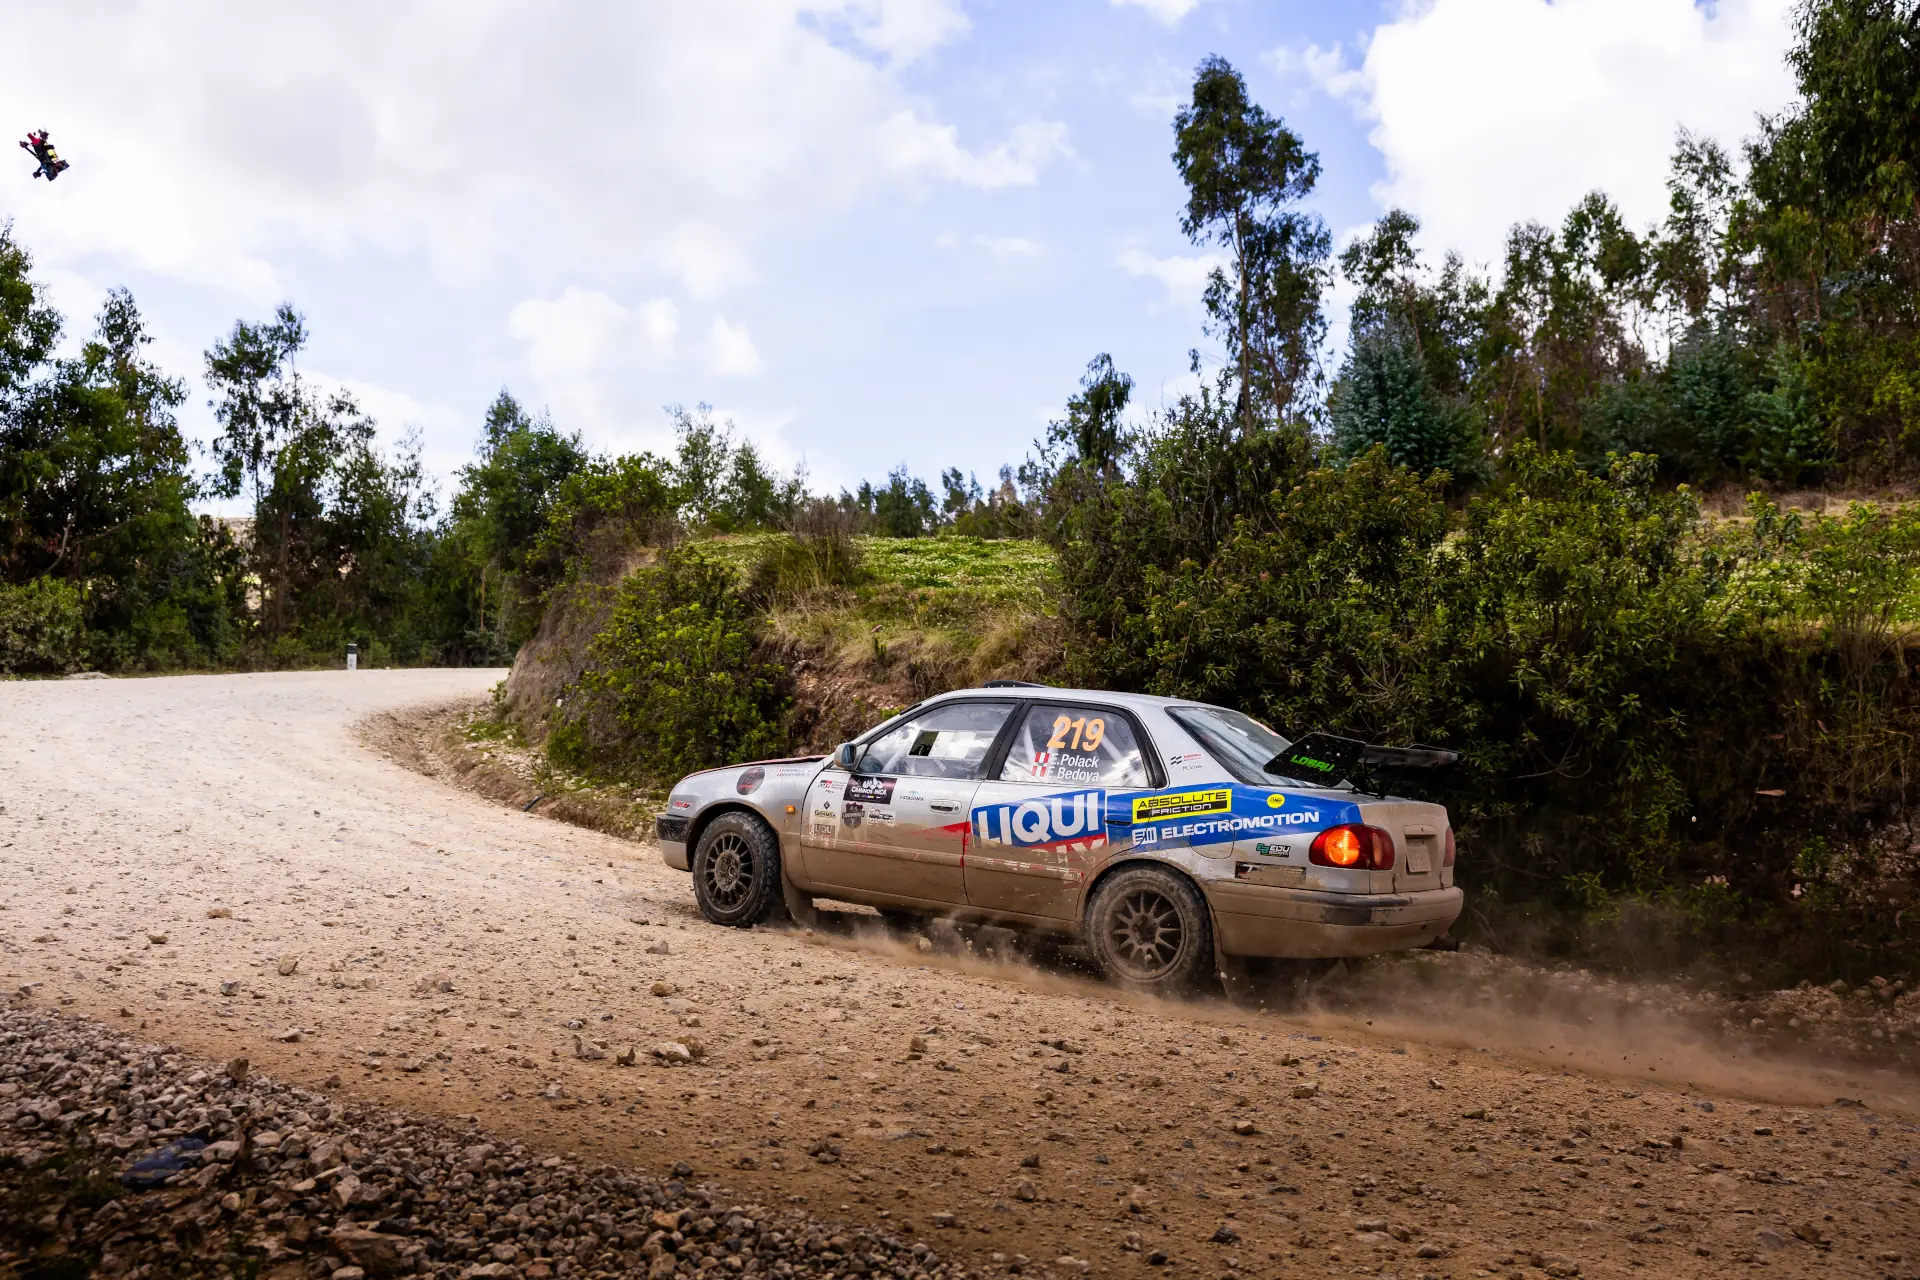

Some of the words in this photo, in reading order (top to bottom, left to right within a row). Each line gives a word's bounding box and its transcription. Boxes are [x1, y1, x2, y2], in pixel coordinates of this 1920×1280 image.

[1046, 716, 1105, 752] 219
[1051, 753, 1099, 769] E.Polack
[1047, 765, 1100, 784] E.Bedoya
[1138, 792, 1227, 809] ABSOLUTE
[1151, 803, 1212, 816] FRICTION
[977, 791, 1099, 846] LIQUI
[1161, 811, 1320, 840] ELECTROMOTION
